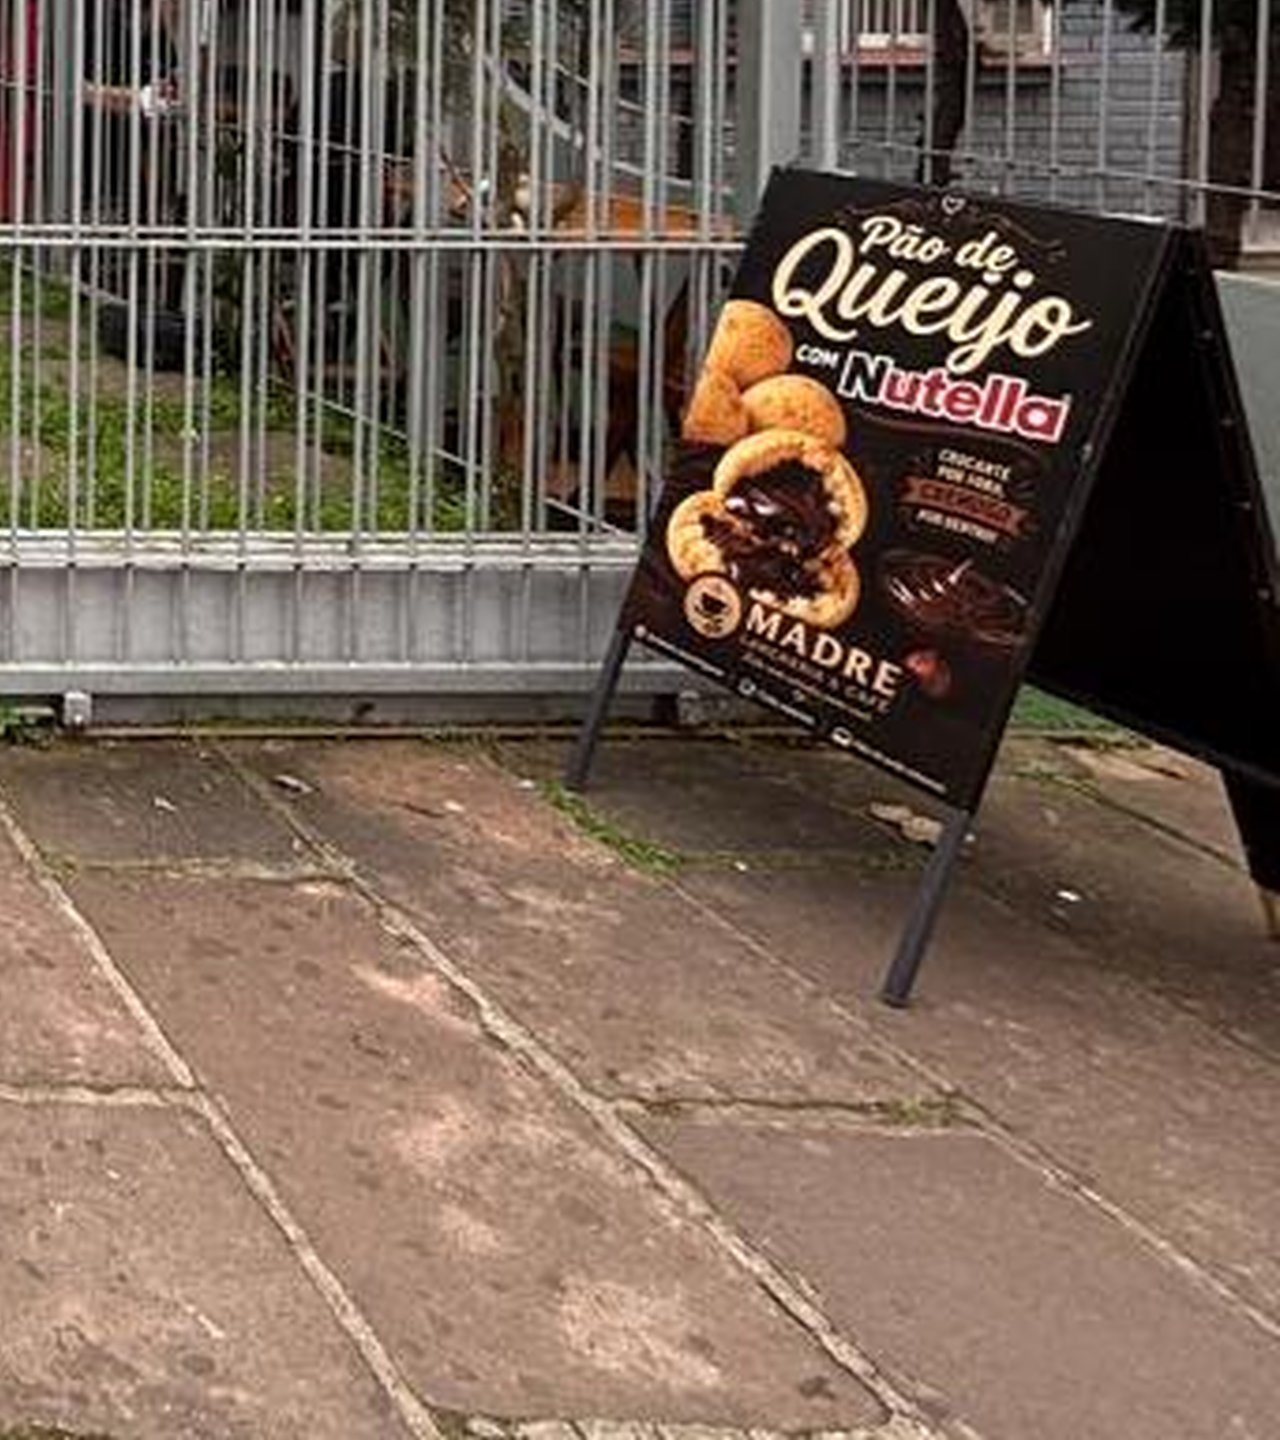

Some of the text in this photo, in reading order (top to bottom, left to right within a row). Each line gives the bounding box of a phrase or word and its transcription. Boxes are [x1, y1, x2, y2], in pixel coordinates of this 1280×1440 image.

[860, 215, 1018, 271] Pão de
[772, 227, 1093, 375] Queijo
[837, 350, 1070, 443] Nutella
[746, 603, 903, 697] MADRE
